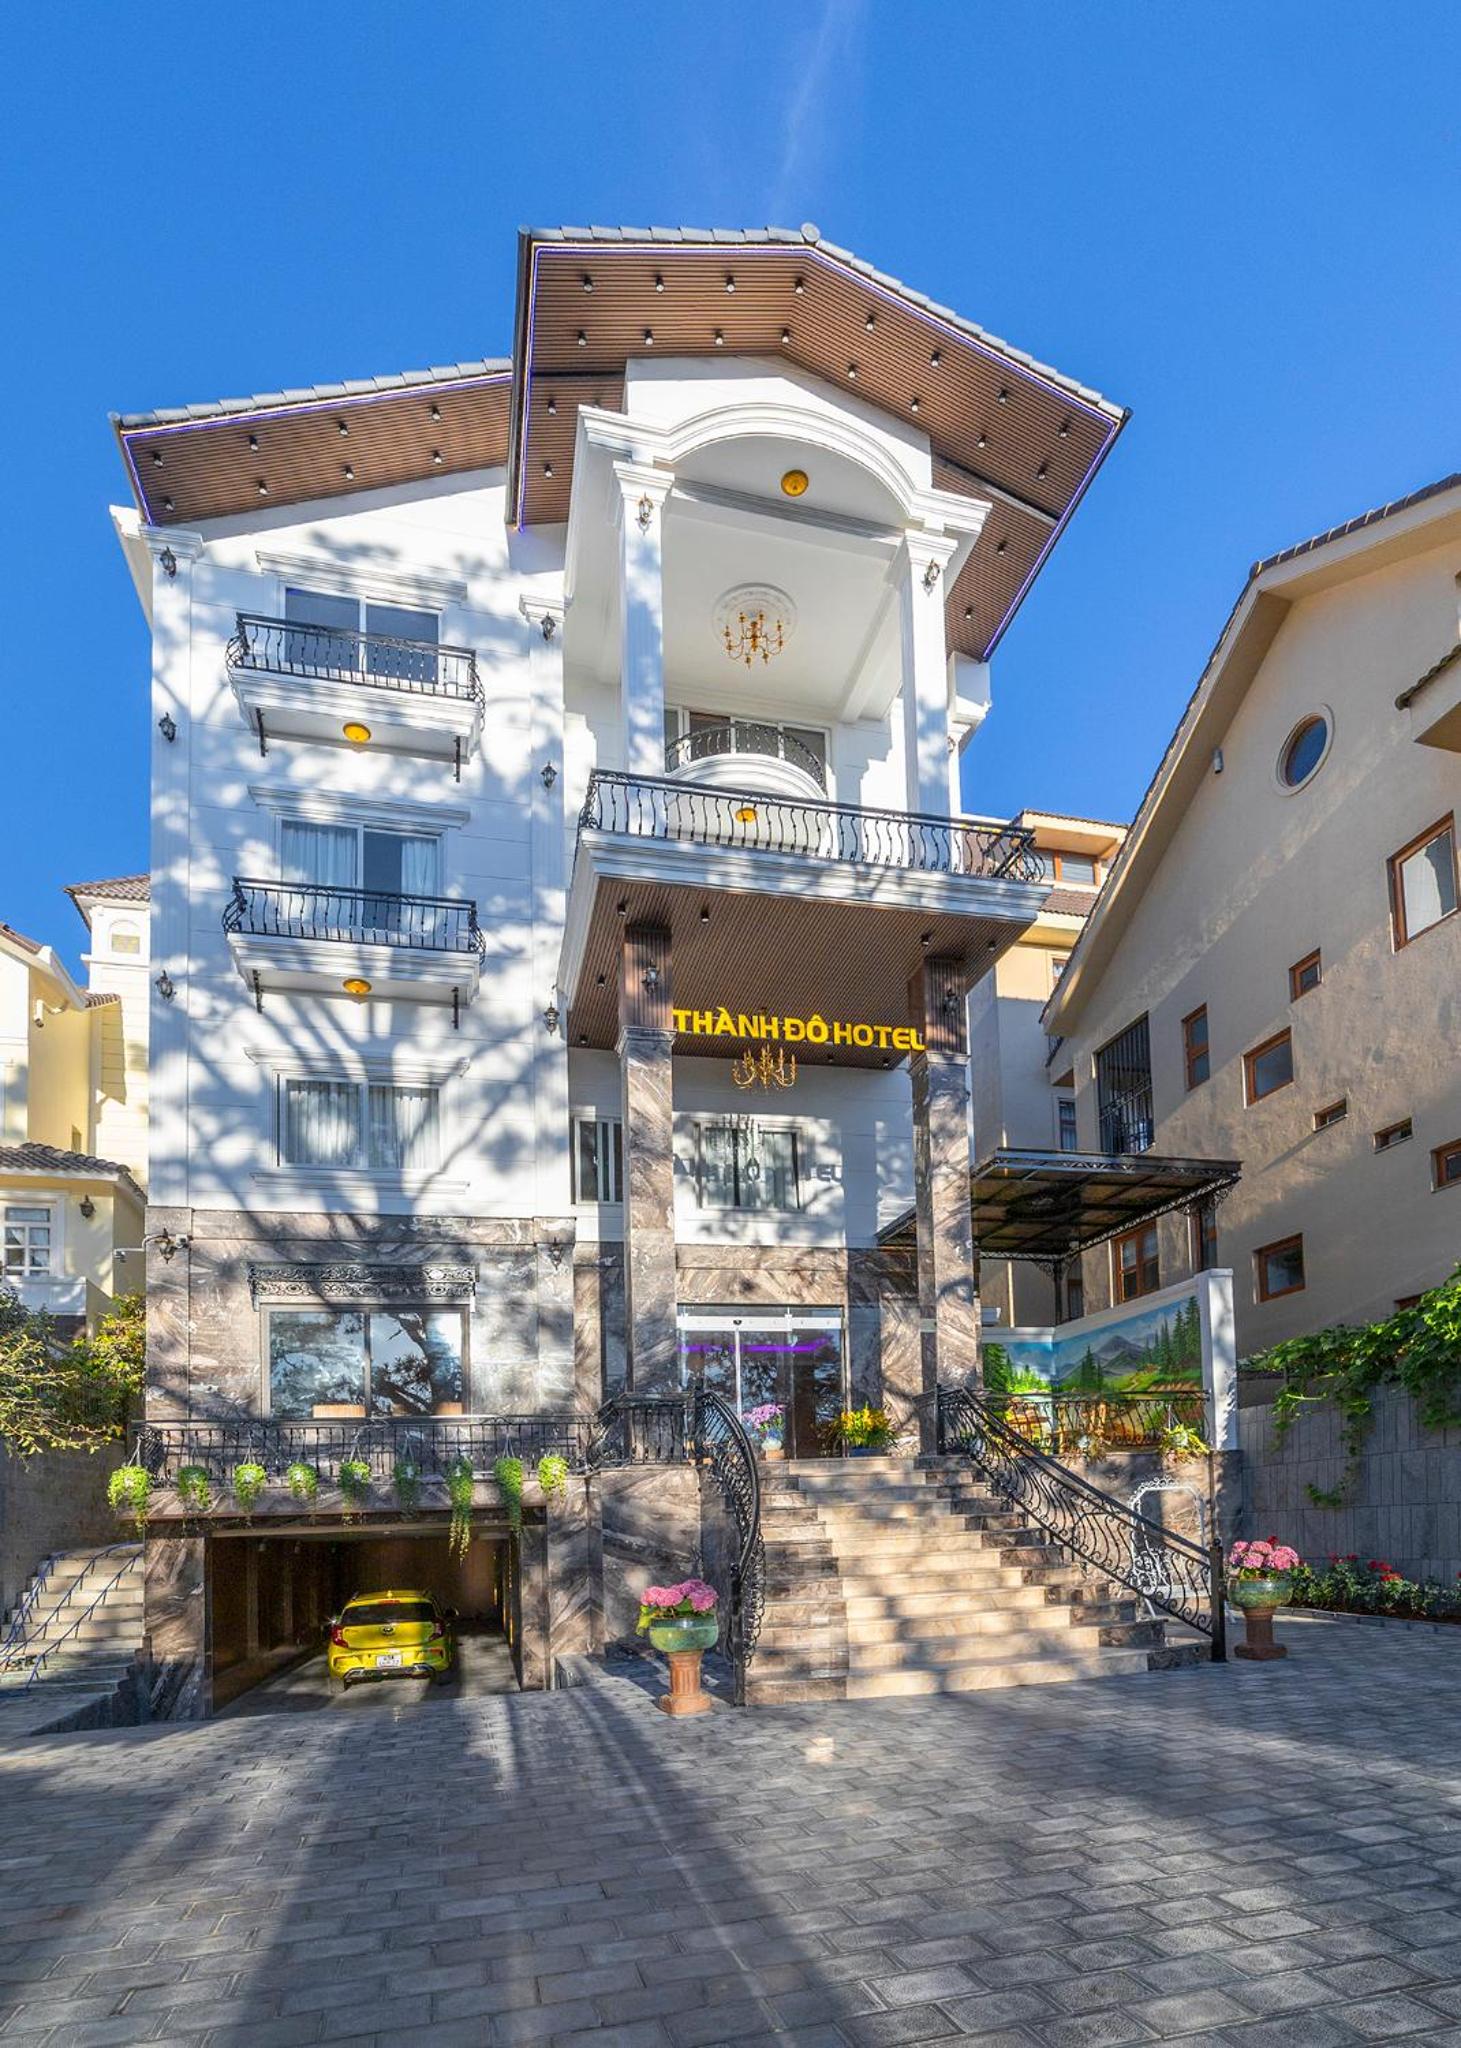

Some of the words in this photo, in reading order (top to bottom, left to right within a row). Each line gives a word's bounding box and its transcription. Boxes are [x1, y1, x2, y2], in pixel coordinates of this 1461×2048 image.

[672, 1006, 779, 1039] THÀNH
[783, 1014, 829, 1043] ĐÔ
[833, 1021, 926, 1050] HOTEL
